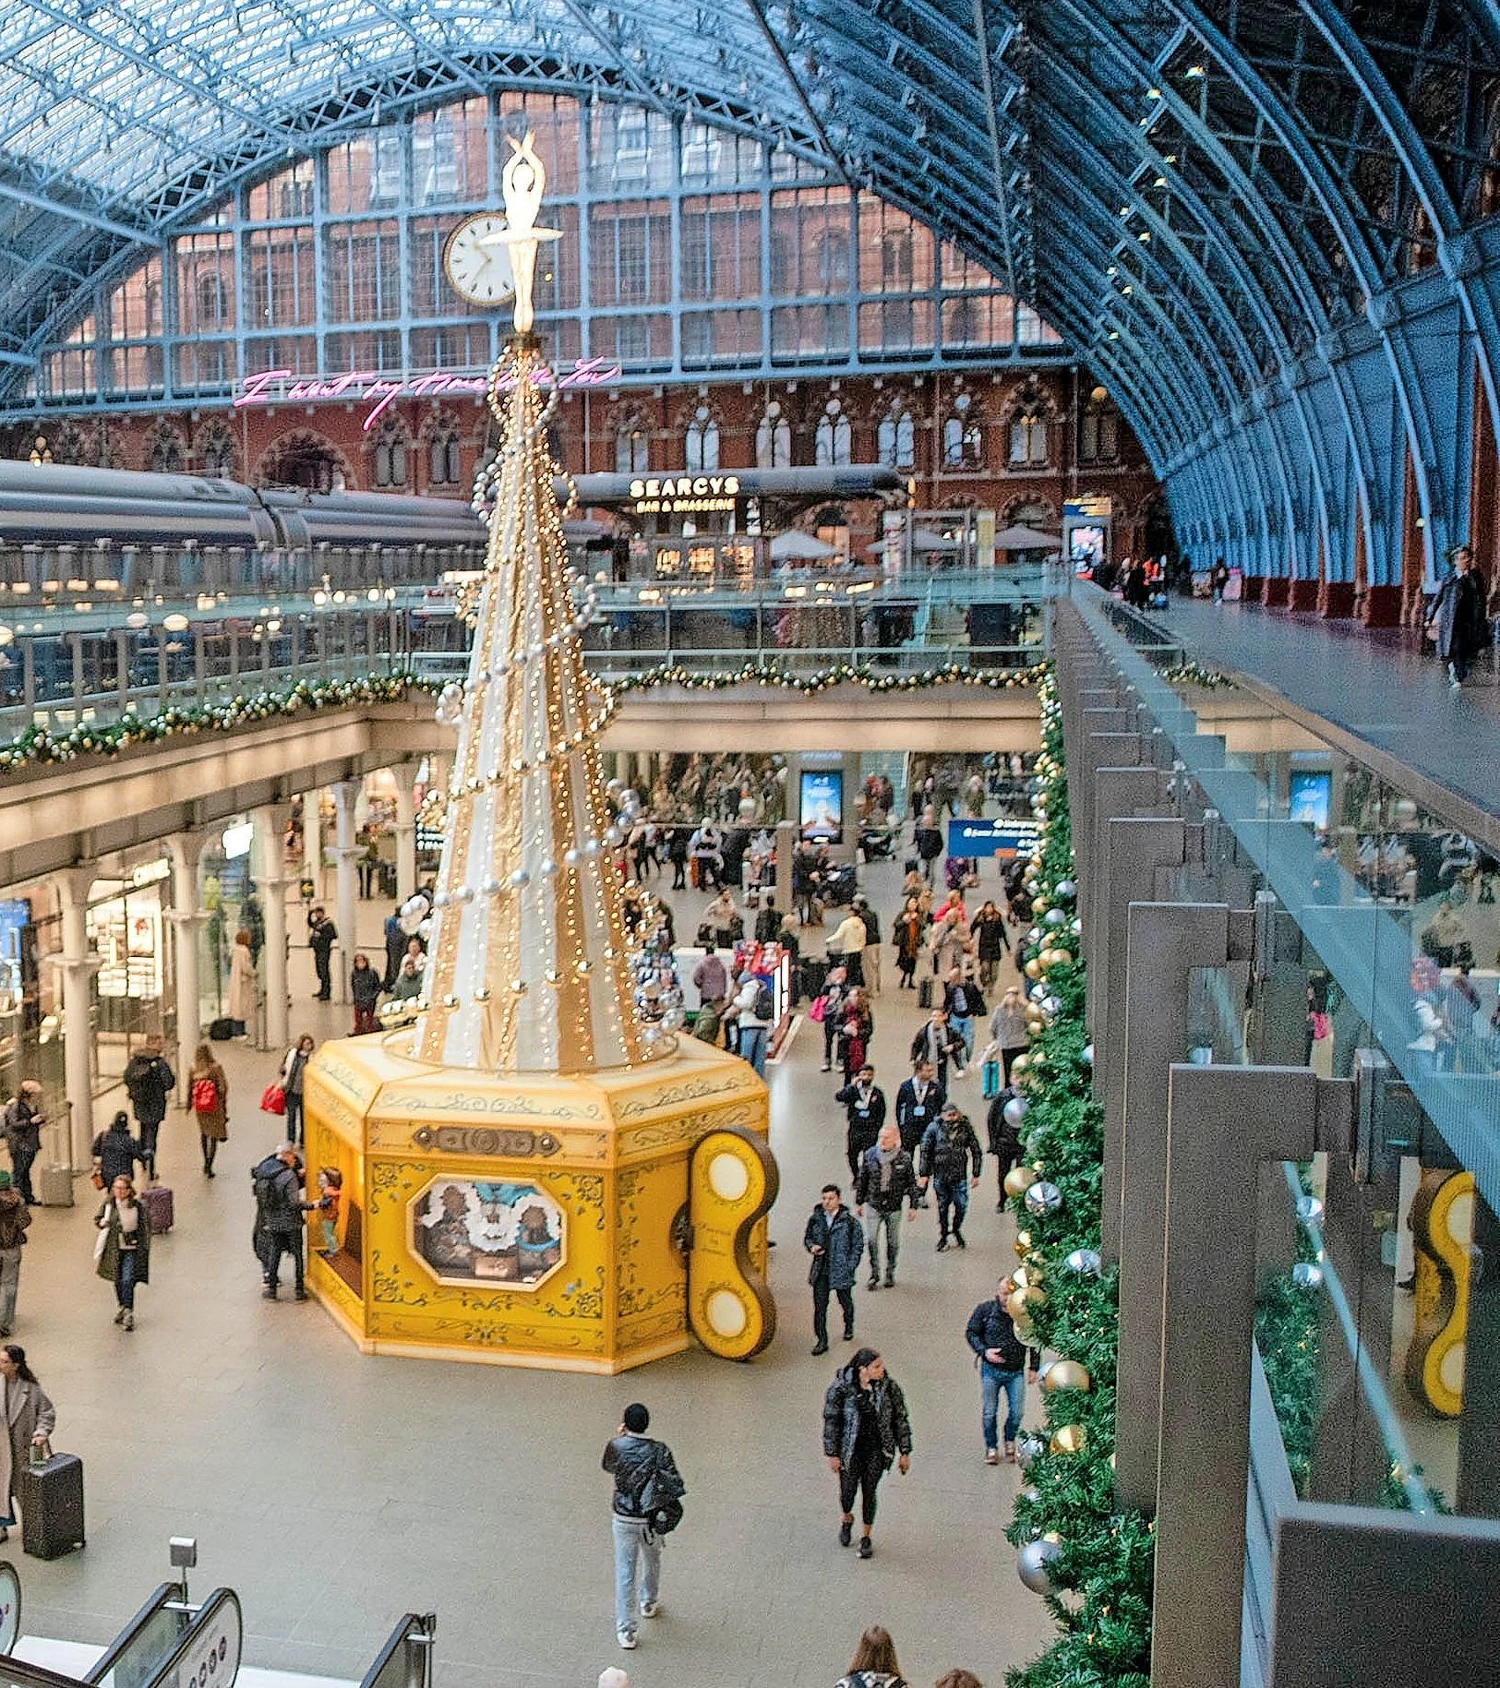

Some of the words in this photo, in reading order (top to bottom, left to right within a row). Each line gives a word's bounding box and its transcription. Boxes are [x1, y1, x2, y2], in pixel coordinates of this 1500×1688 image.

[234, 369, 292, 407] I
[288, 371, 376, 399] want
[362, 378, 405, 431] my
[408, 371, 487, 397] time
[558, 355, 620, 389] You
[629, 476, 740, 498] SEARCYS
[636, 500, 661, 514] BAR
[661, 499, 672, 513] &
[673, 497, 736, 513] BRASSERIE
